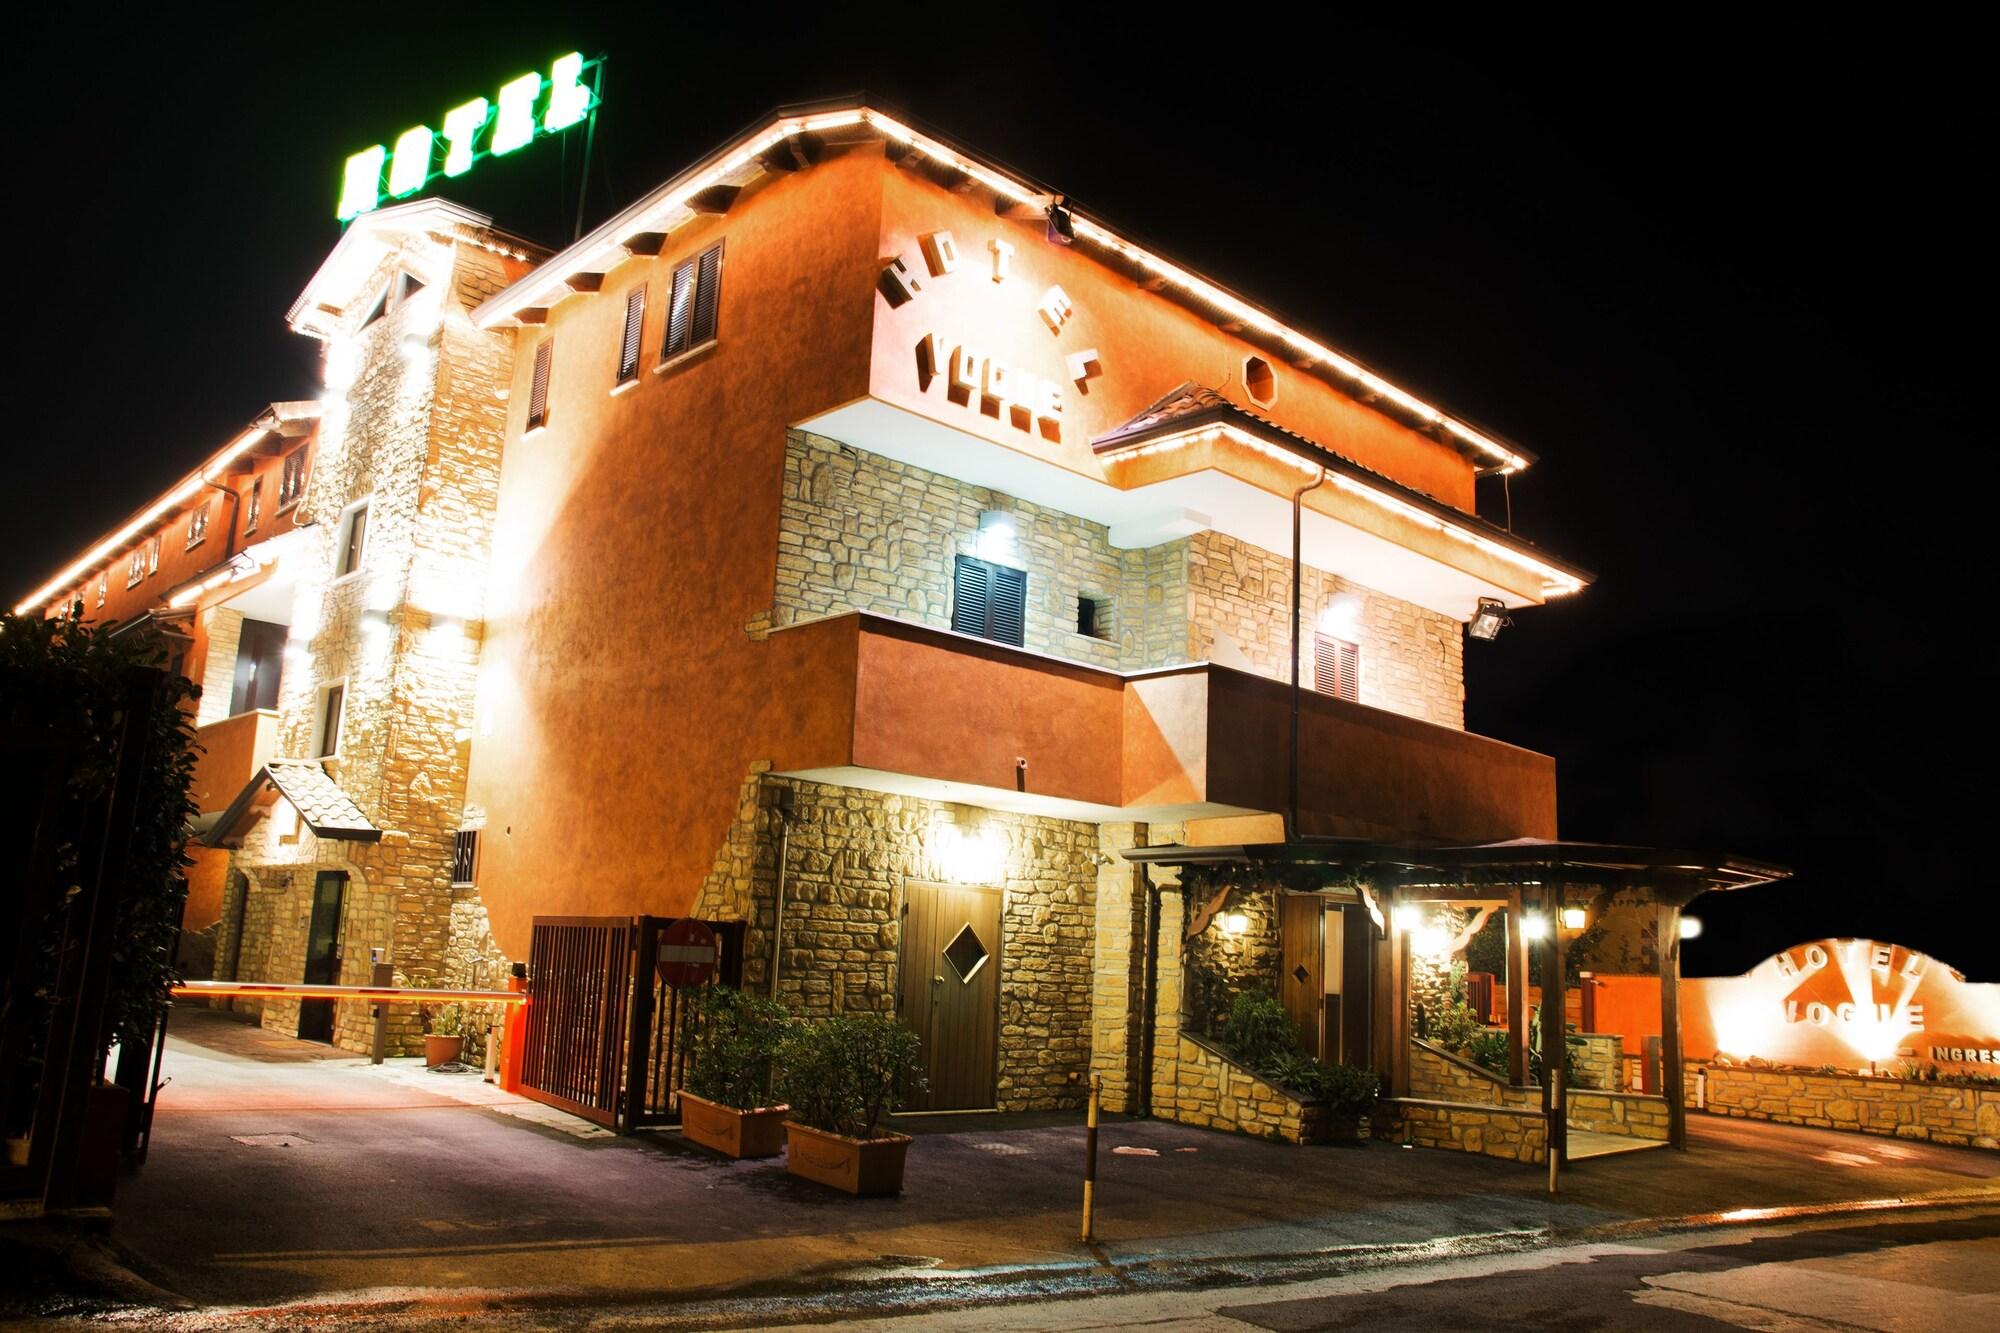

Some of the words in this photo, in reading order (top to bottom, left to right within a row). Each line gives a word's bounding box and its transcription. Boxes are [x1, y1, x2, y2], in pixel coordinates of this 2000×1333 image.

[337, 51, 591, 222] HOTEL
[877, 230, 1103, 395] HOTEL
[1776, 940, 1929, 983] HOTEL
[1782, 1000, 1925, 1032] VOGUE
